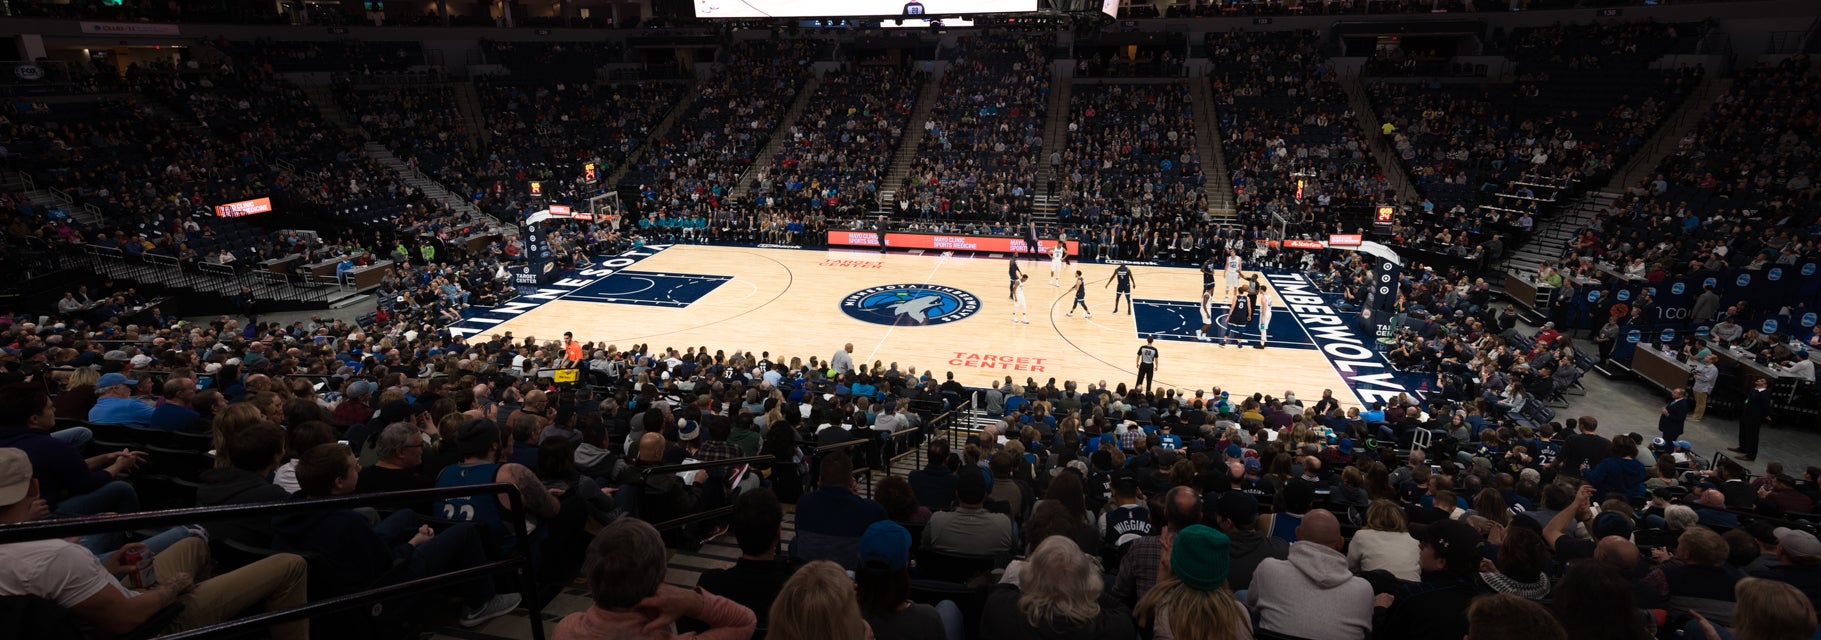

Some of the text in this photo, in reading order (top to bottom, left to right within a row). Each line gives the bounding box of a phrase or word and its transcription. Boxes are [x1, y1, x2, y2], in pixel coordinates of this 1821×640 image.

[845, 284, 977, 322] MINNESOTA TIMBERWOLVES
[1267, 273, 1411, 410] TIMBERWOLVE
[948, 359, 1046, 372] CENTER
[953, 352, 1047, 365] TARGET
[1113, 520, 1152, 535] WIGGINS
